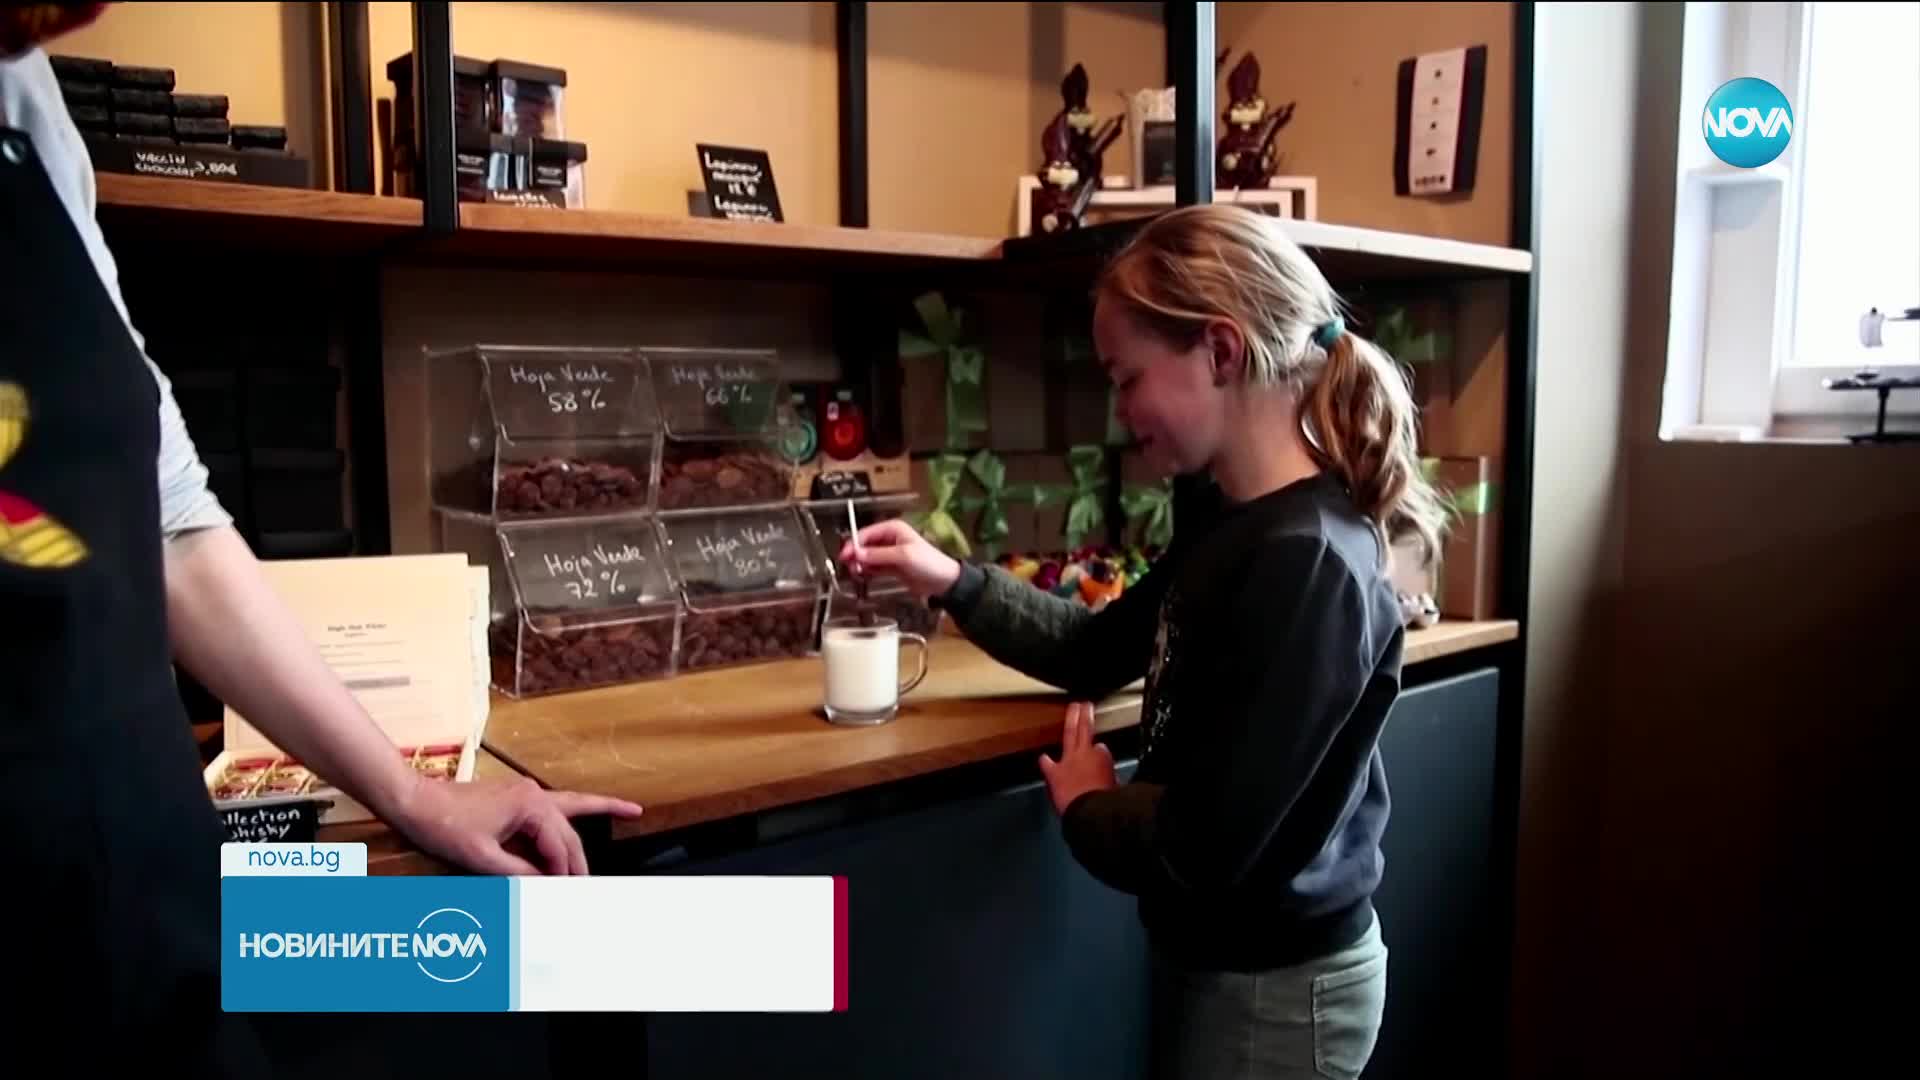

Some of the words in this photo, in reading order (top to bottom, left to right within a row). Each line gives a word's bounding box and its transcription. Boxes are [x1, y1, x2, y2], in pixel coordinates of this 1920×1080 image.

[509, 363, 557, 393] Hoja
[695, 535, 741, 563] Hoja
[543, 553, 593, 580] Hoja
